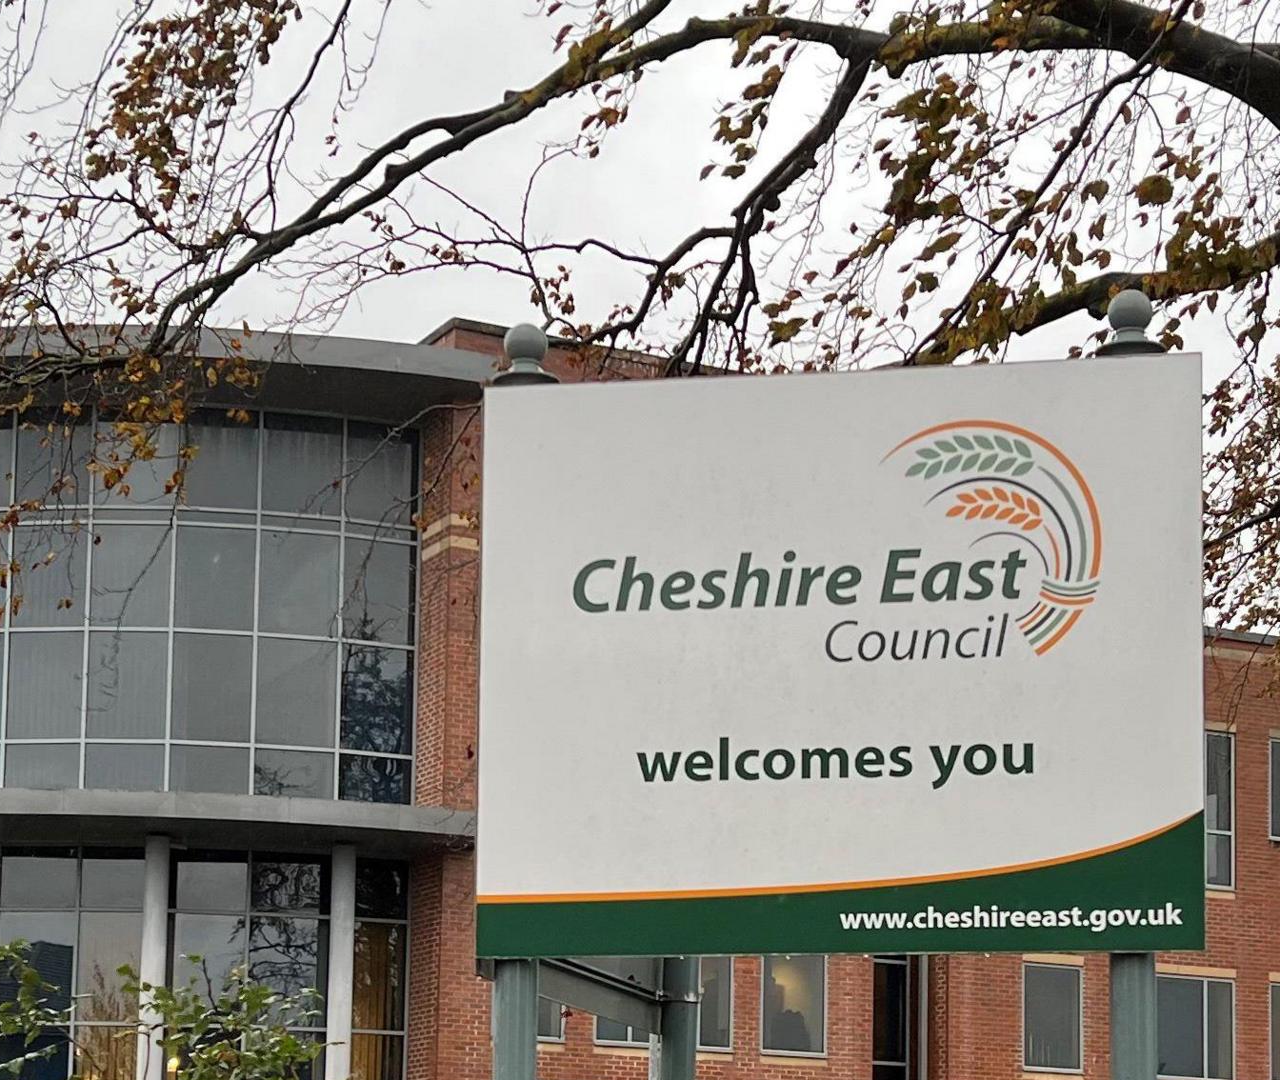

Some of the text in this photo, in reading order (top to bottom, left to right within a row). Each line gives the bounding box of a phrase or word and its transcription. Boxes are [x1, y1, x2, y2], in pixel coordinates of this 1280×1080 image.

[573, 548, 1029, 615] Cheshire East
[824, 613, 1012, 664] Council
[636, 737, 1036, 791] welcomes you
[840, 903, 1185, 933] www.cheshireeast.gov.uk
